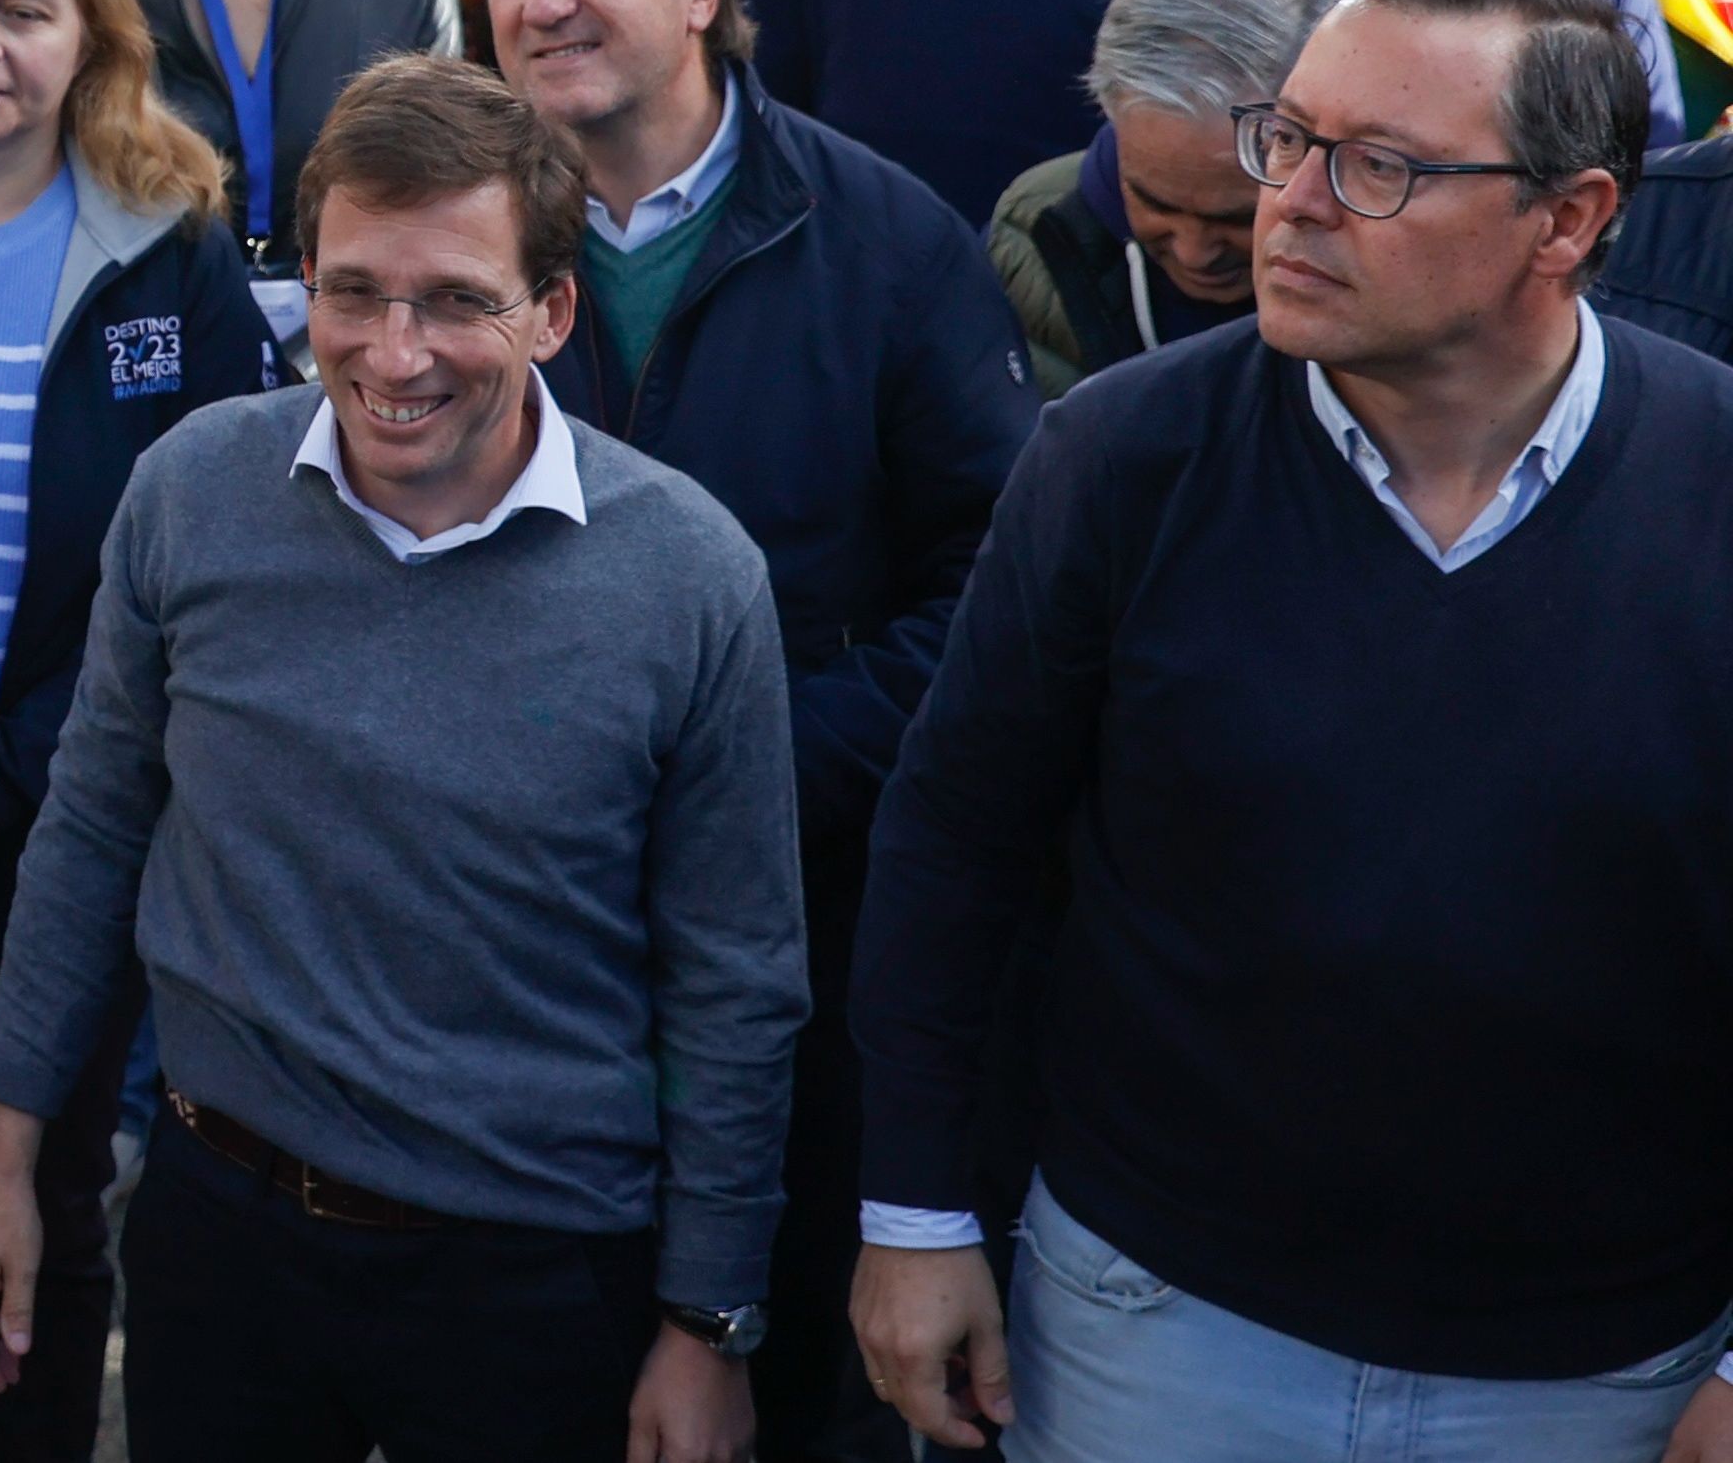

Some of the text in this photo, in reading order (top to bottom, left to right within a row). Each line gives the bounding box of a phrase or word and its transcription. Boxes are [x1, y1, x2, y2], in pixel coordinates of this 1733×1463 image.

[104, 315, 181, 341] DESTINO
[110, 359, 181, 383] EL MEJOR
